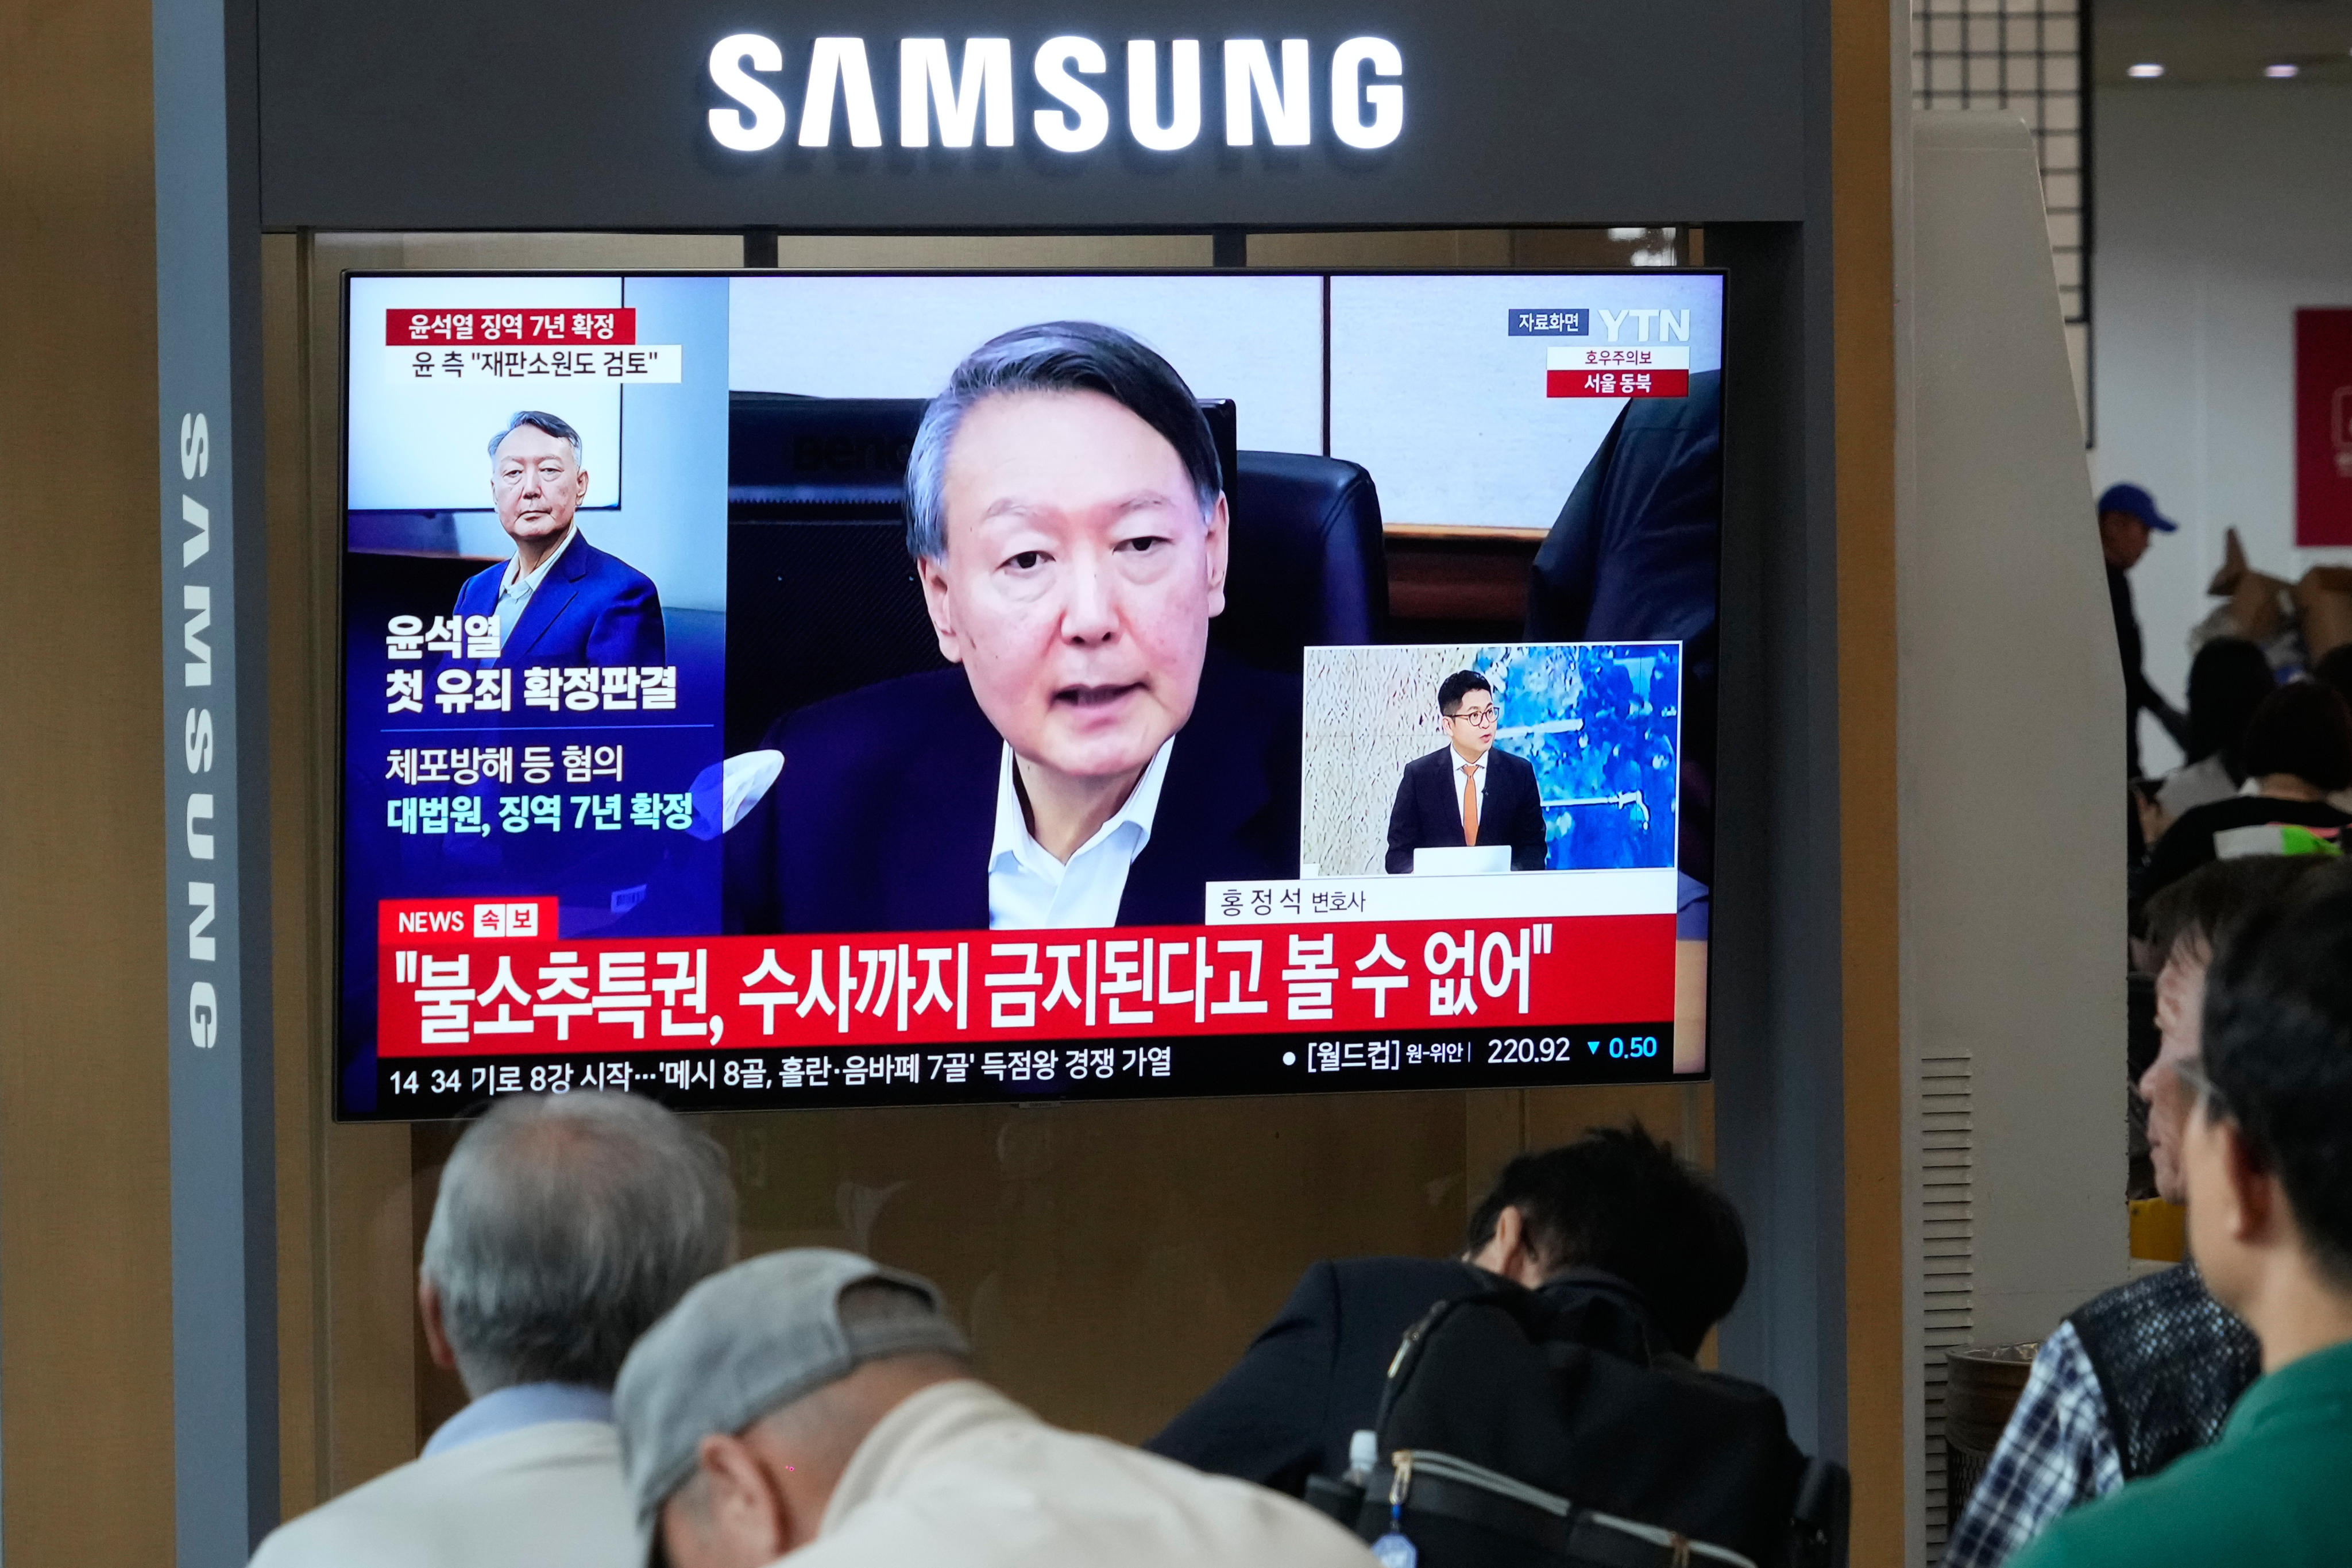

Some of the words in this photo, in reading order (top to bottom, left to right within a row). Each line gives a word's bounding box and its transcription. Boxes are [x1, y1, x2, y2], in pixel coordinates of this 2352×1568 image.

[708, 33, 1404, 153] SAMSUNG
[408, 314, 473, 340] 윤석열
[481, 314, 523, 340] 징역
[530, 314, 565, 339] 7년
[571, 313, 614, 339] 확정
[1519, 312, 1578, 333] 자료화면
[1597, 309, 1690, 342] YTN
[412, 352, 435, 377] 윤
[442, 350, 465, 378] 측
[472, 350, 596, 377] "재판소원도
[604, 350, 658, 377] 검토"
[1585, 350, 1652, 366] 호우주의보
[1584, 373, 1617, 393] 서울
[1619, 373, 1652, 393] 동북
[386, 613, 503, 659] 윤석열
[386, 669, 423, 713] 첫
[435, 668, 511, 713] 유죄
[524, 666, 676, 712] 확정판결
[180, 413, 217, 1048] SAMSUNG
[385, 747, 513, 785] 체포방해
[520, 747, 554, 783] 등
[561, 744, 623, 782] 혐의
[387, 795, 491, 837] 대법원,
[498, 794, 561, 833] 징역
[570, 793, 621, 831] 7년
[629, 792, 693, 830] 확정
[1312, 890, 1366, 913] 변호사
[399, 910, 464, 933] NEWS
[395, 948, 724, 1046] "불소추특권,
[739, 942, 968, 1035] 수사까지
[984, 936, 1268, 1028] 금지된다고
[1281, 933, 1339, 1020] 볼
[1351, 933, 1409, 1018] 수
[1424, 923, 1552, 1016] 없어"
[1308, 1040, 1400, 1073] [월드컵]
[1405, 1042, 1464, 1064] 원-위안
[1488, 1037, 1570, 1064] 220.92
[1609, 1036, 1657, 1059] 0.50
[390, 1071, 419, 1095] 14
[431, 1069, 462, 1094] 34
[529, 1061, 574, 1095] 8강
[723, 1059, 772, 1089] 8골,
[778, 1053, 920, 1088] 홀란·음바페
[927, 1053, 975, 1083] 7골'
[980, 1049, 1059, 1082] 득점왕
[1065, 1048, 1114, 1079] 경쟁
[1122, 1046, 1171, 1077] 가열
